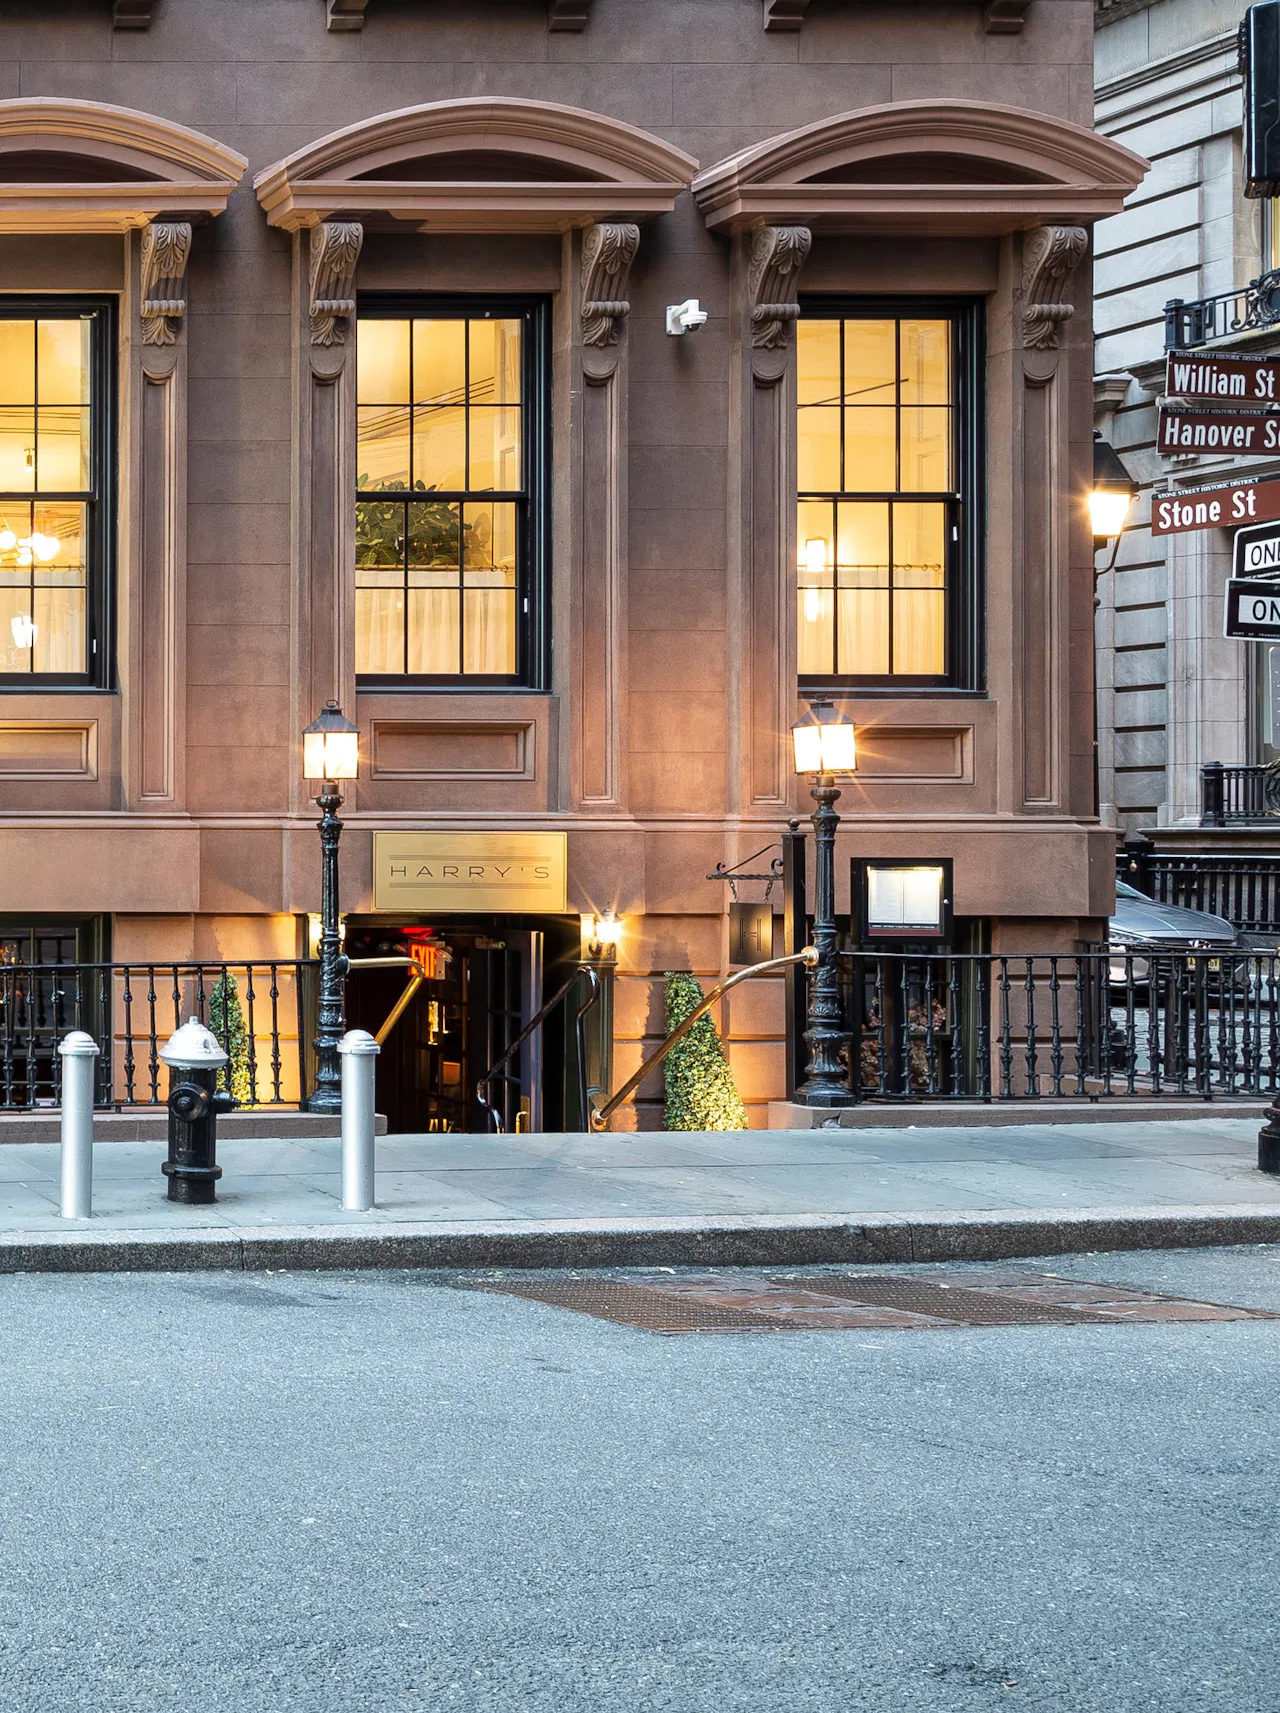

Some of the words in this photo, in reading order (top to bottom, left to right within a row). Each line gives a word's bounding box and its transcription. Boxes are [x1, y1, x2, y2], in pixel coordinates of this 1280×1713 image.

[1174, 363, 1246, 396] William
[1254, 369, 1275, 398] St
[1164, 417, 1255, 447] Hanover
[1263, 419, 1280, 448] S
[1178, 487, 1201, 496] STREET
[1230, 477, 1260, 488] DISTRICT
[1158, 500, 1221, 530] Stone
[1231, 489, 1257, 519] St
[390, 865, 549, 879] HARRY'S
[739, 917, 761, 951] H
[411, 943, 436, 978] EXIT
